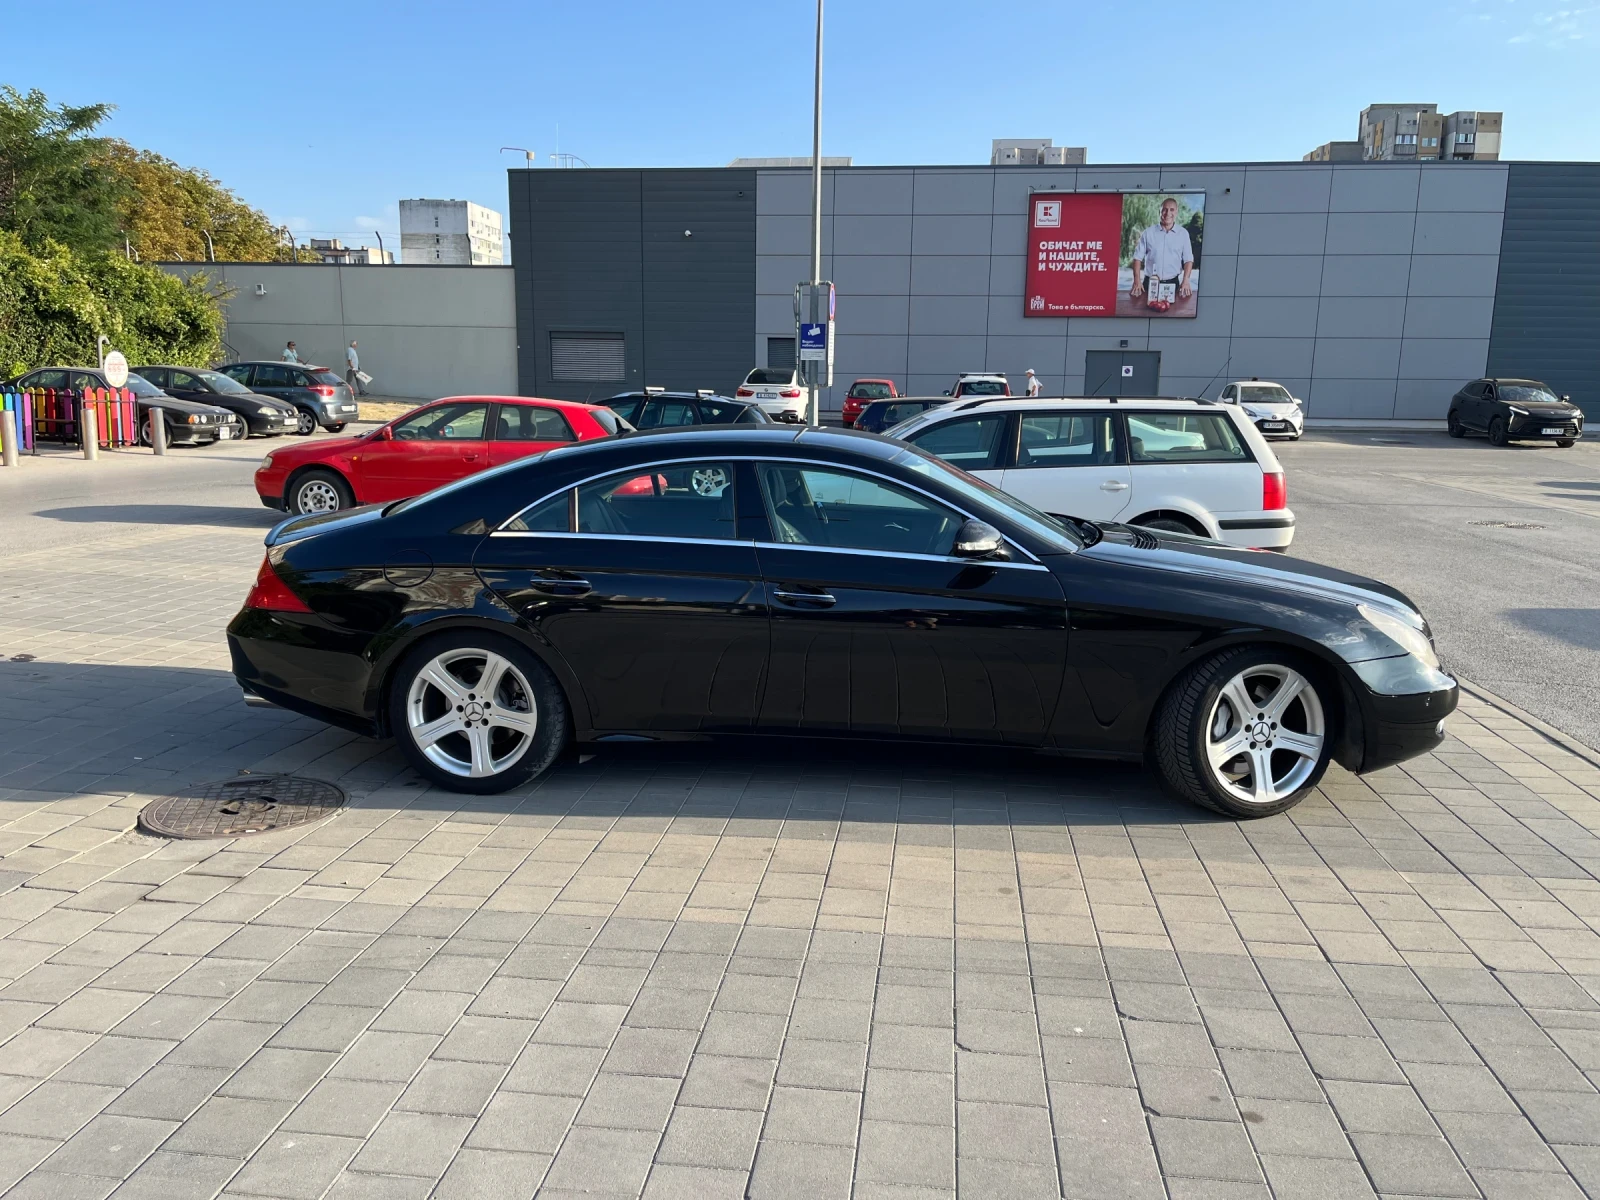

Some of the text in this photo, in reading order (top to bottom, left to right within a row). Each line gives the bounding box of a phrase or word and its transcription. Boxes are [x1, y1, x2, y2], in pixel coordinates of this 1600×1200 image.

[1043, 206, 1053, 216] K
[1040, 241, 1103, 250] ОБИЧАТ МЕ
[1038, 252, 1100, 262] И НАШИТЕ,
[1038, 262, 1107, 272] И ЧУЖДИТЕ.
[1070, 303, 1106, 312] българско.
